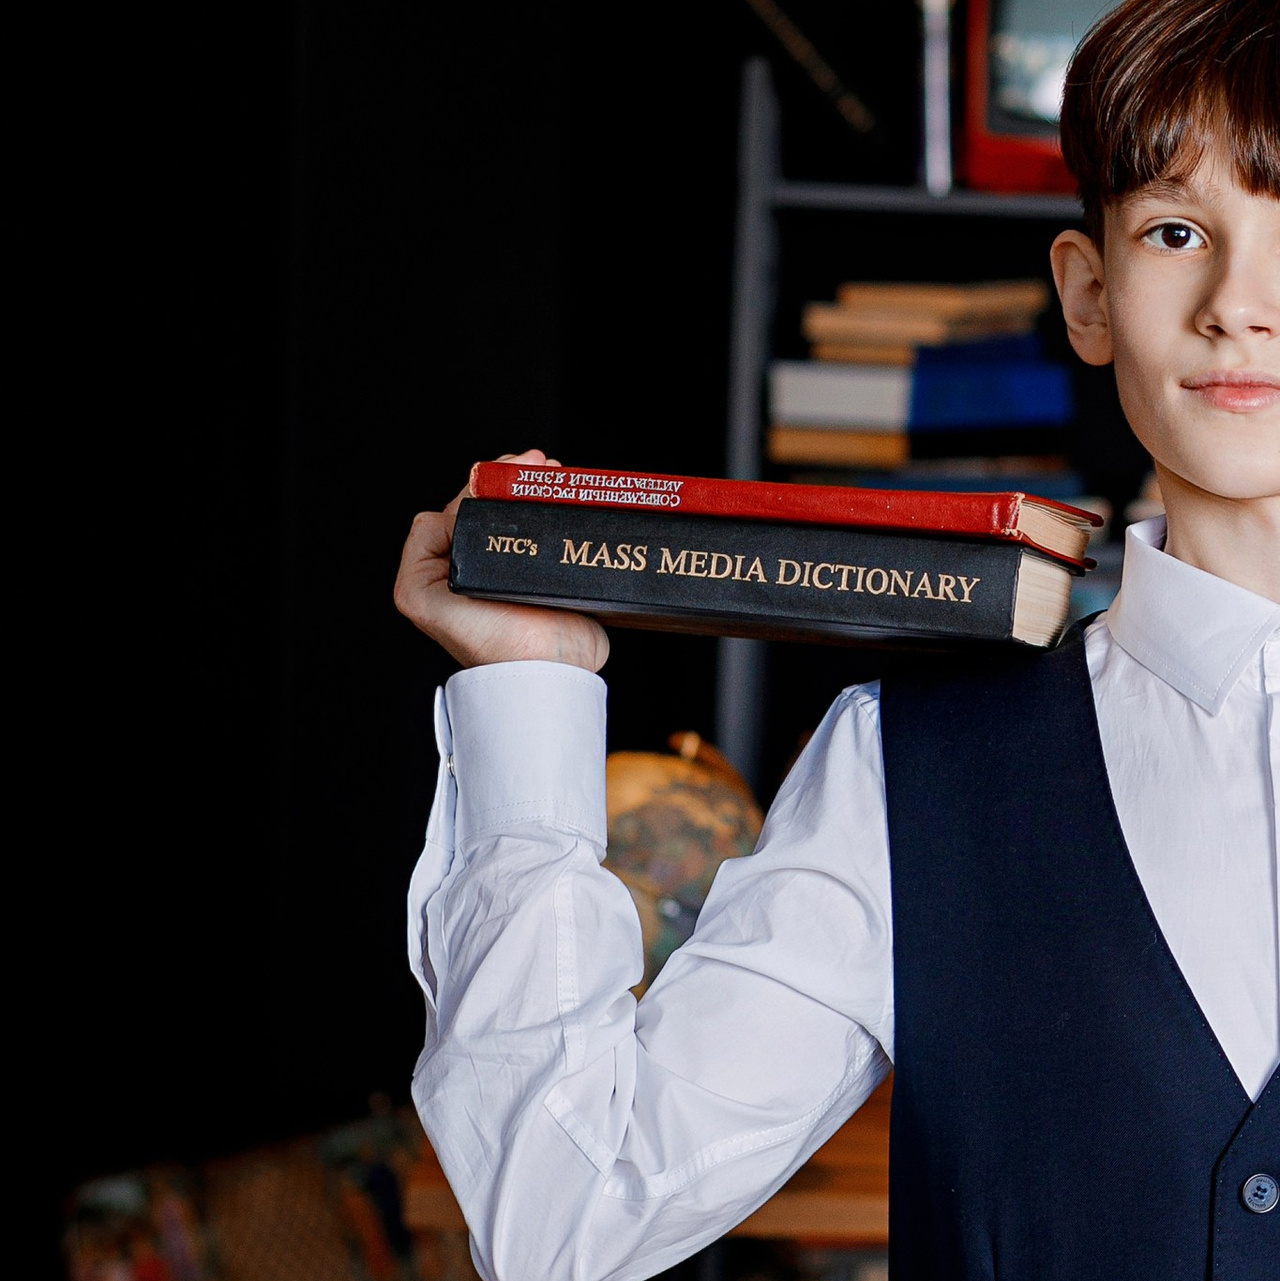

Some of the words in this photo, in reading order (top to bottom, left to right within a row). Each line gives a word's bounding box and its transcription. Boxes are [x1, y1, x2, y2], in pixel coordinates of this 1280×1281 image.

[517, 469, 567, 484] ЯЗЫК
[568, 473, 683, 492] ЛИТЕРАТУРНЫЙ
[511, 483, 576, 499] РУССКИЙ
[579, 488, 681, 507] СОВРЕМЕННЫЙ
[560, 538, 648, 571] MASS
[657, 547, 768, 583] MEDIA
[775, 559, 981, 604] DICTIONARY
